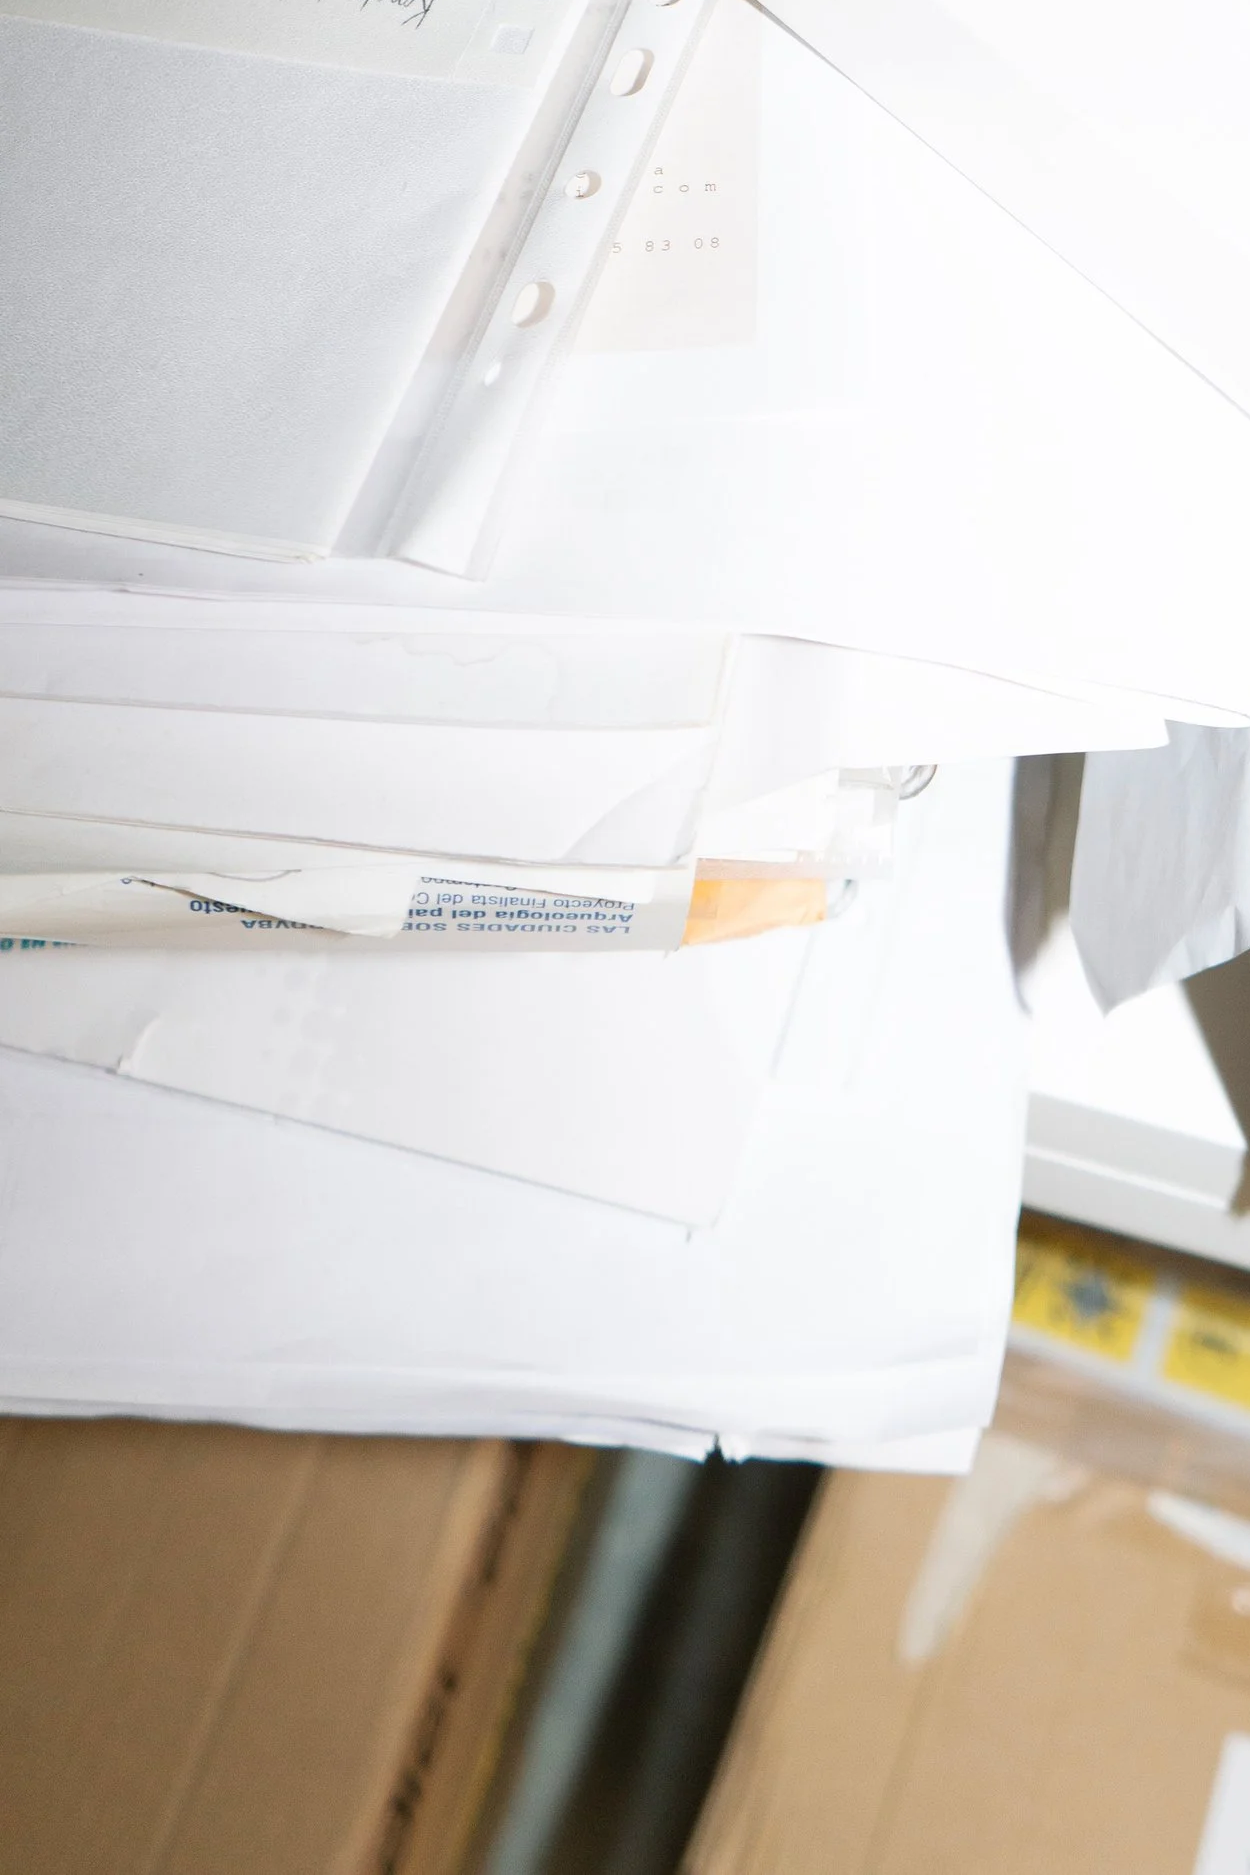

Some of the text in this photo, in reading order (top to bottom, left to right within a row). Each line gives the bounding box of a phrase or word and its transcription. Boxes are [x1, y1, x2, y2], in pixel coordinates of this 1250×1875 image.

[436, 892, 464, 906] del
[470, 894, 547, 910] Finalista
[451, 909, 487, 920] del
[457, 923, 578, 933] CIUDADES
[585, 925, 631, 934] LAS
